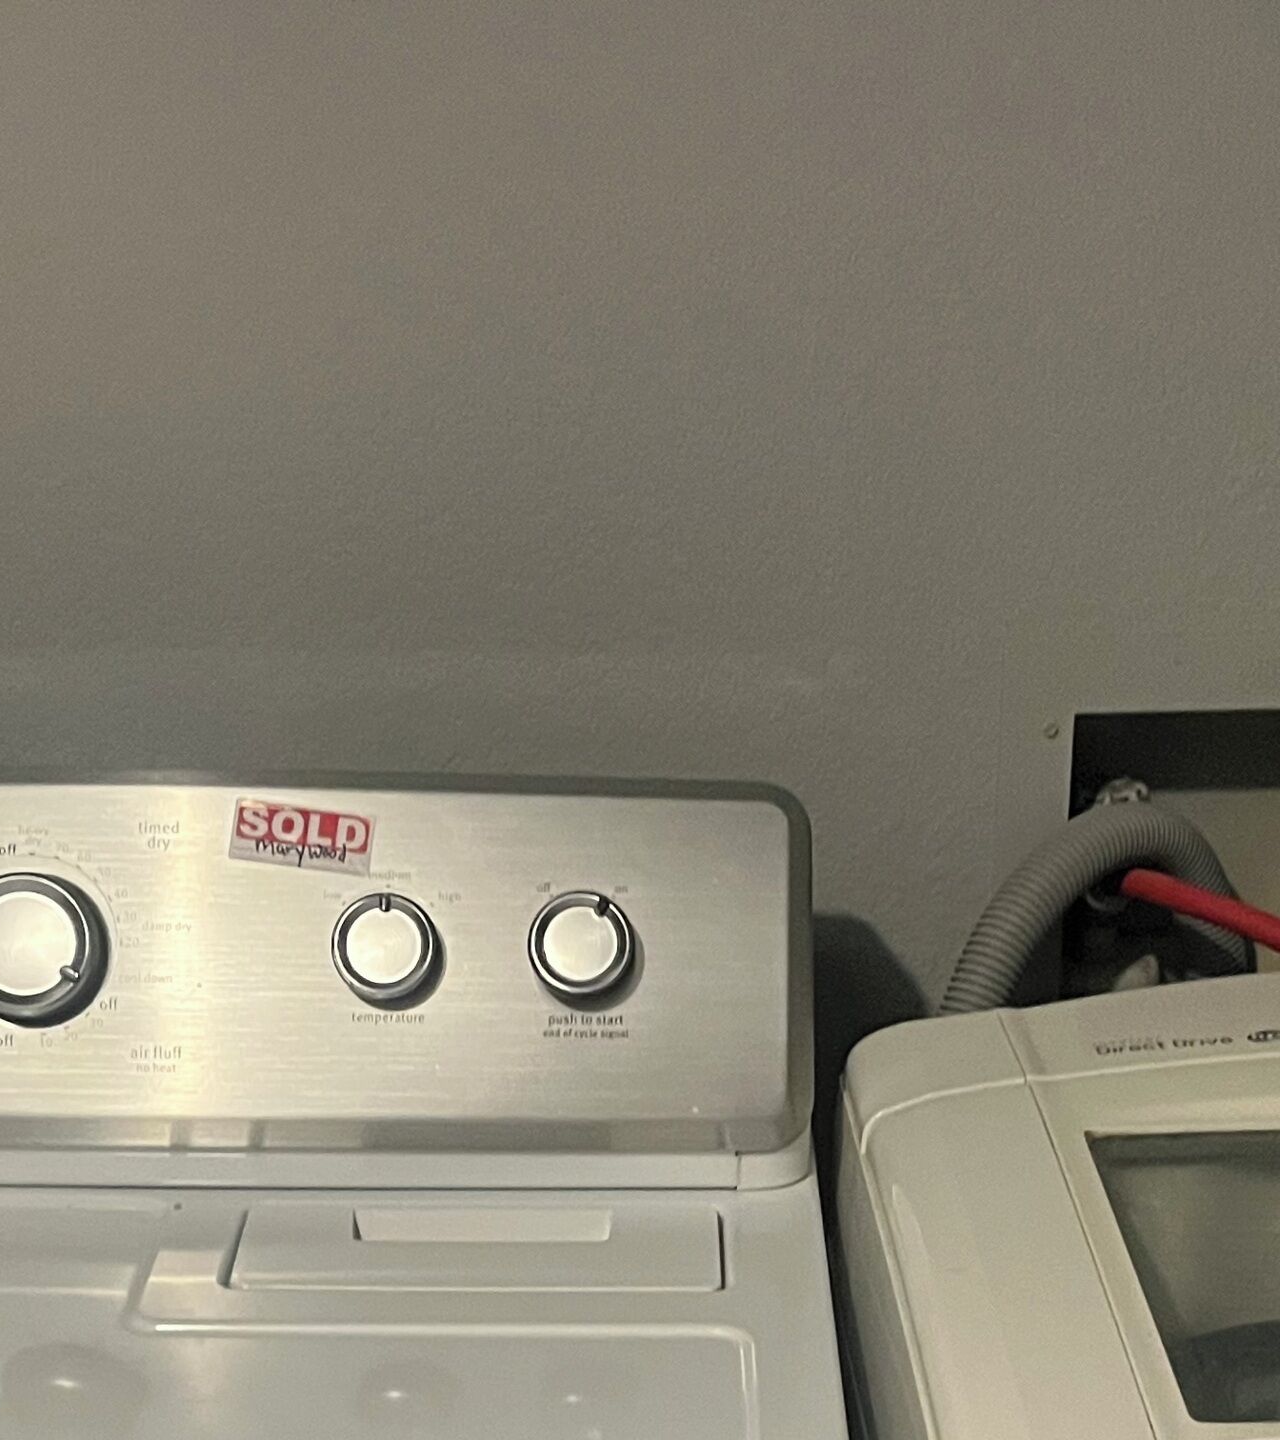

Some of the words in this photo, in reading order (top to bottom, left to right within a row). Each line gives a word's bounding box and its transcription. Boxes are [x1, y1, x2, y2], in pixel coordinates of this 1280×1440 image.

[138, 820, 181, 834] timed
[240, 805, 367, 849] SOLD
[147, 836, 171, 851] dry
[99, 997, 118, 1011] off
[351, 1012, 425, 1025] temperature
[548, 1013, 578, 1027] push
[581, 1014, 593, 1025] to
[596, 1014, 624, 1025] start
[131, 1046, 150, 1060] air
[153, 1046, 182, 1060] fluff
